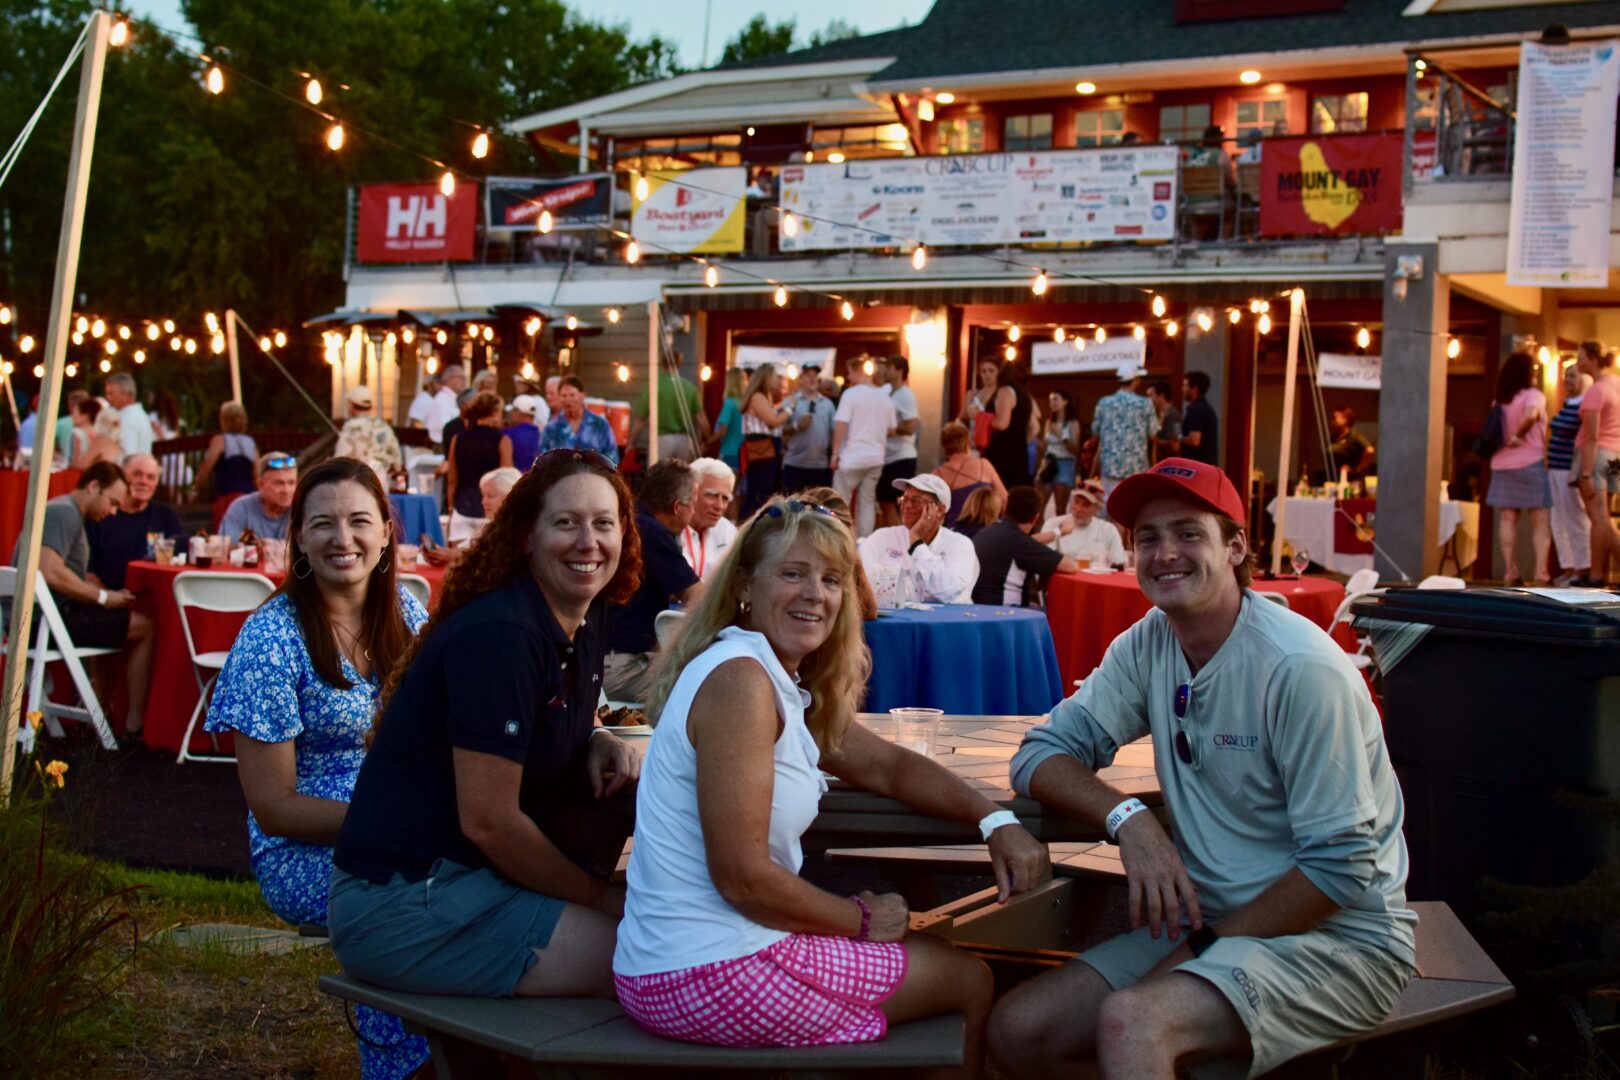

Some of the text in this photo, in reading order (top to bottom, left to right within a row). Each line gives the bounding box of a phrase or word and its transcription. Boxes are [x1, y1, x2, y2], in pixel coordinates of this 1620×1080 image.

[1278, 168, 1381, 191] MOUNT GAY
[386, 194, 447, 237] HH
[646, 206, 725, 224] Boatyard
